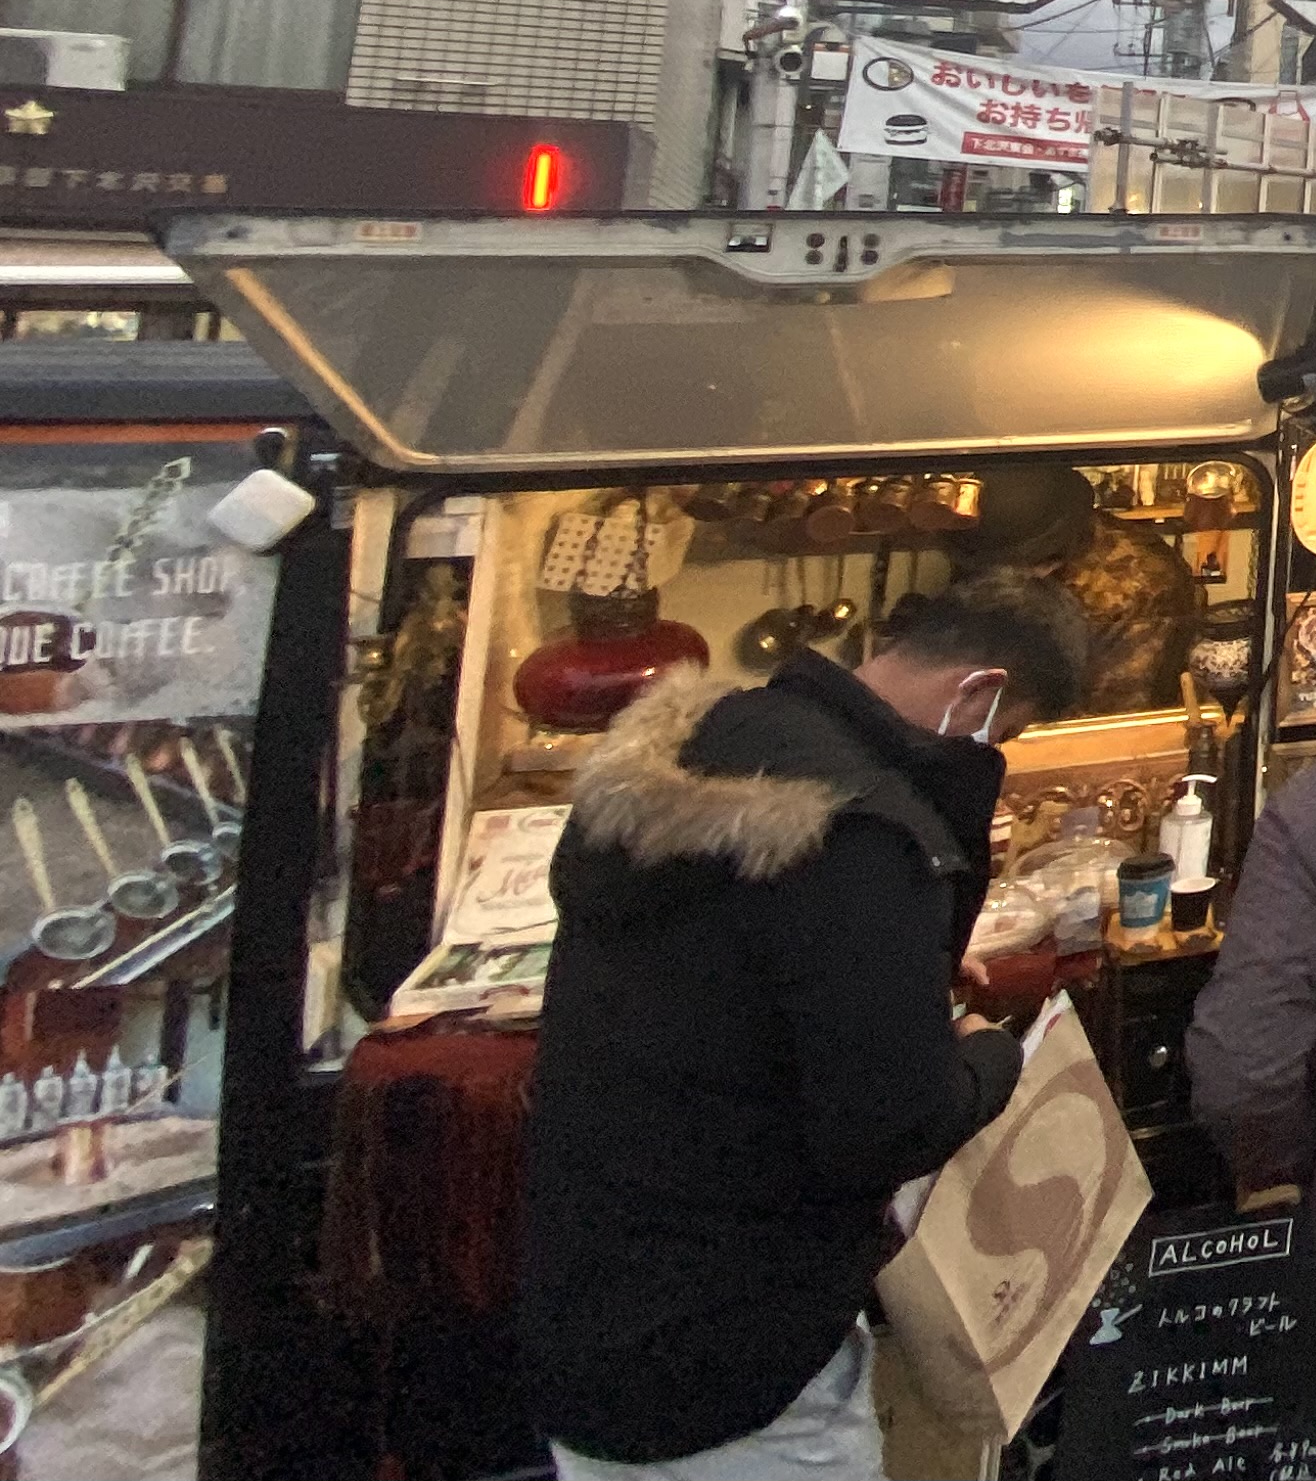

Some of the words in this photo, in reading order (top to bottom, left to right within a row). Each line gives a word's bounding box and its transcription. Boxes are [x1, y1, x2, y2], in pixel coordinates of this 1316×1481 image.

[931, 60, 1187, 104] おいしいを
[1159, 1228, 1279, 1266] ALCOHOL
